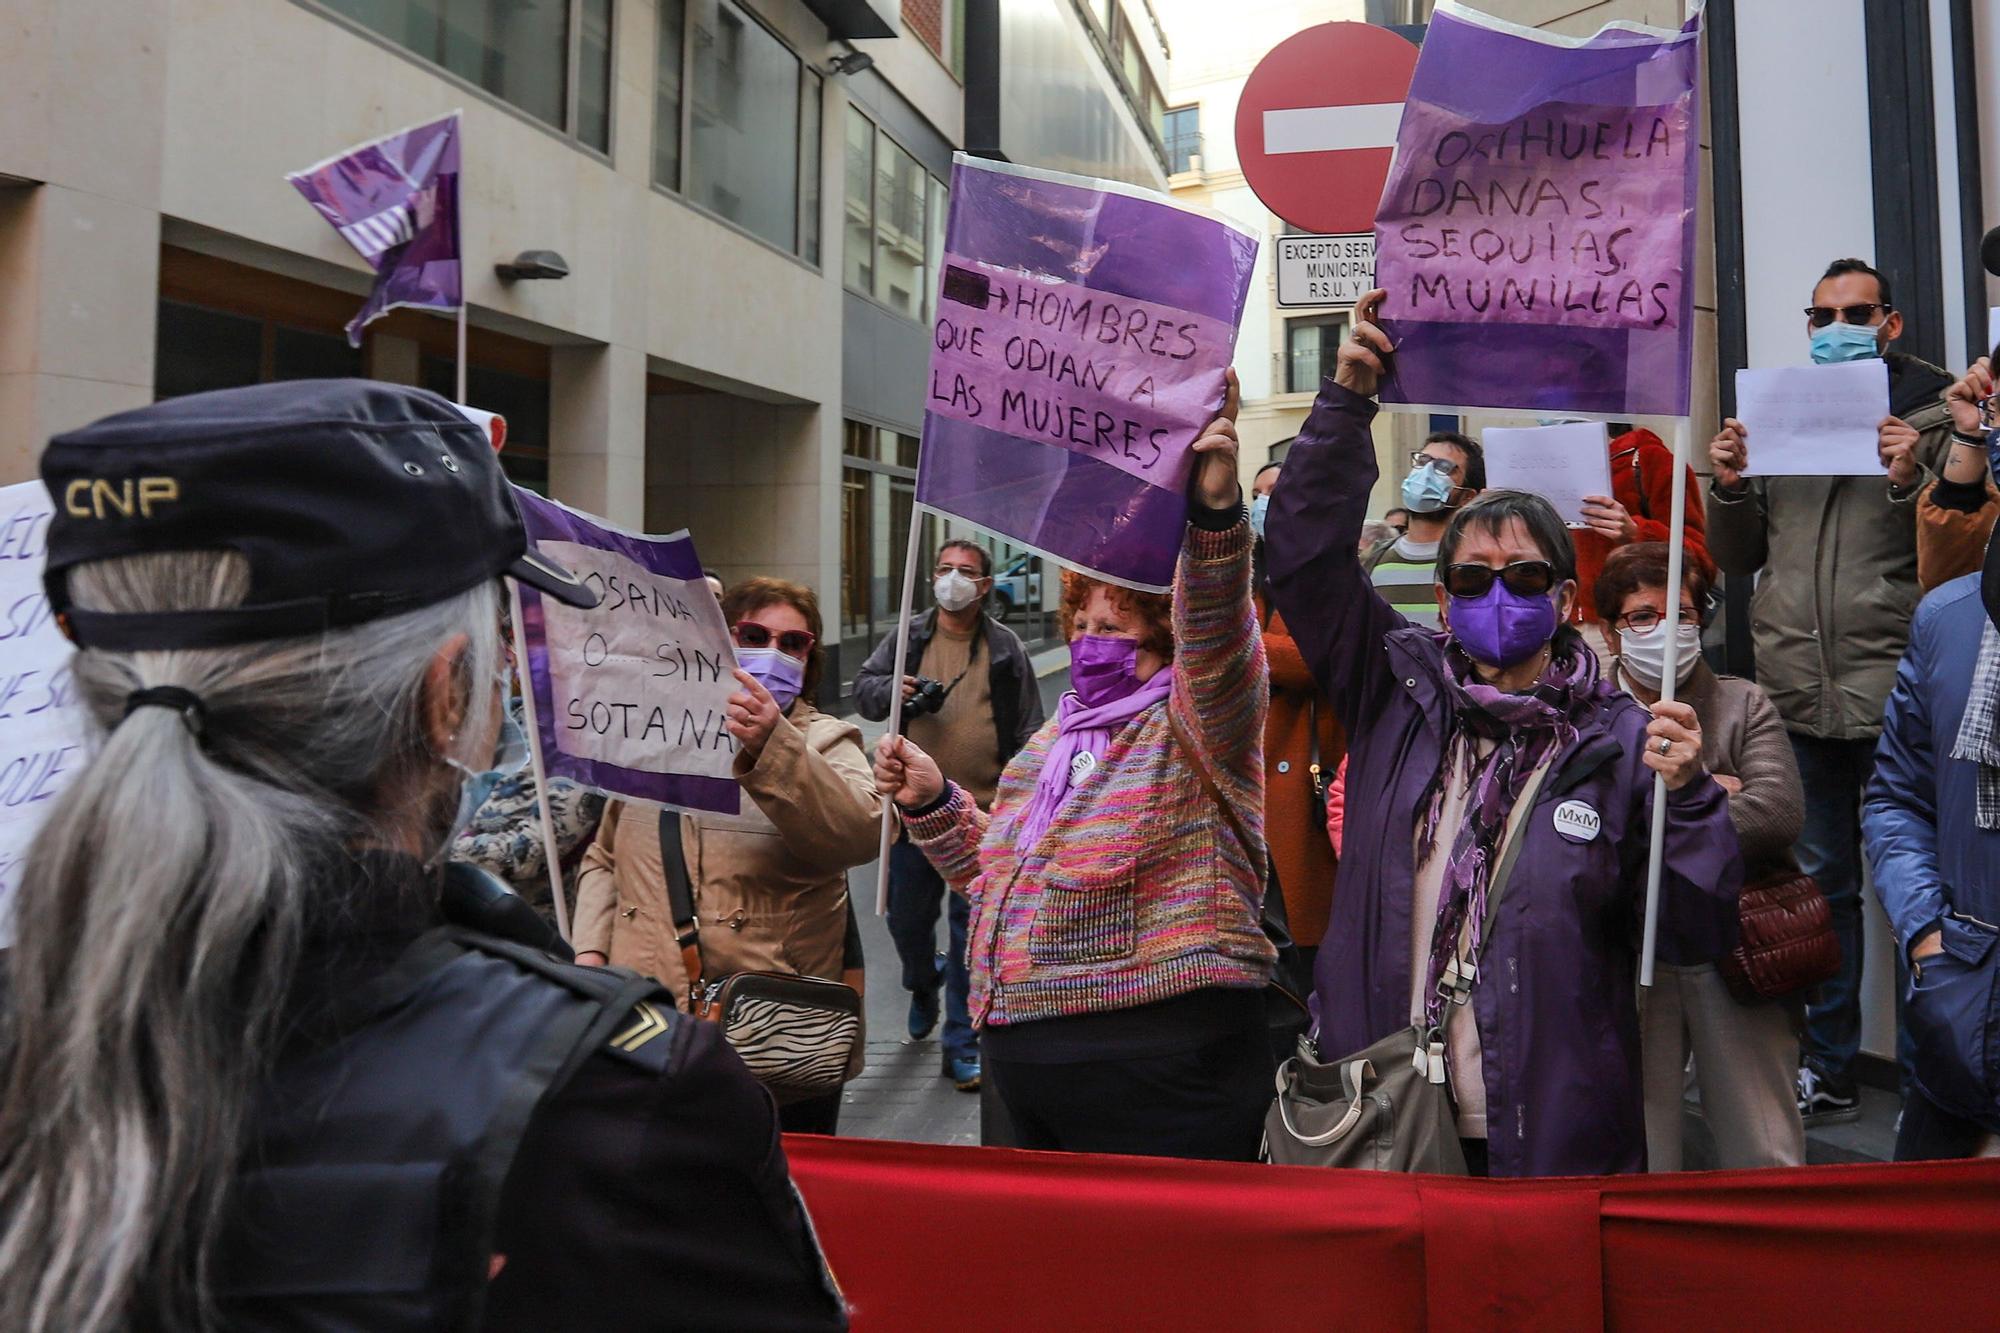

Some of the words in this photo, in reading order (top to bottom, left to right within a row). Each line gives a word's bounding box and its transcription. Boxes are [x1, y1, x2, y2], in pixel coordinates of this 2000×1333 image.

[1285, 243, 1341, 260] EXCEPTO
[1307, 261, 1375, 279] MUNICIPAL
[1309, 282, 1346, 298] R.S.U.
[1352, 281, 1361, 297] Y
[1014, 285, 1199, 360] HOMBRES
[935, 318, 985, 358] QUE
[1129, 376, 1155, 408] A
[932, 369, 982, 418] LAS
[66, 477, 179, 520] CNP
[575, 571, 697, 623] OSANA
[583, 632, 609, 667] O
[652, 641, 721, 683] SIN
[567, 699, 734, 754] SOTANA
[1557, 807, 1599, 829] MxM
